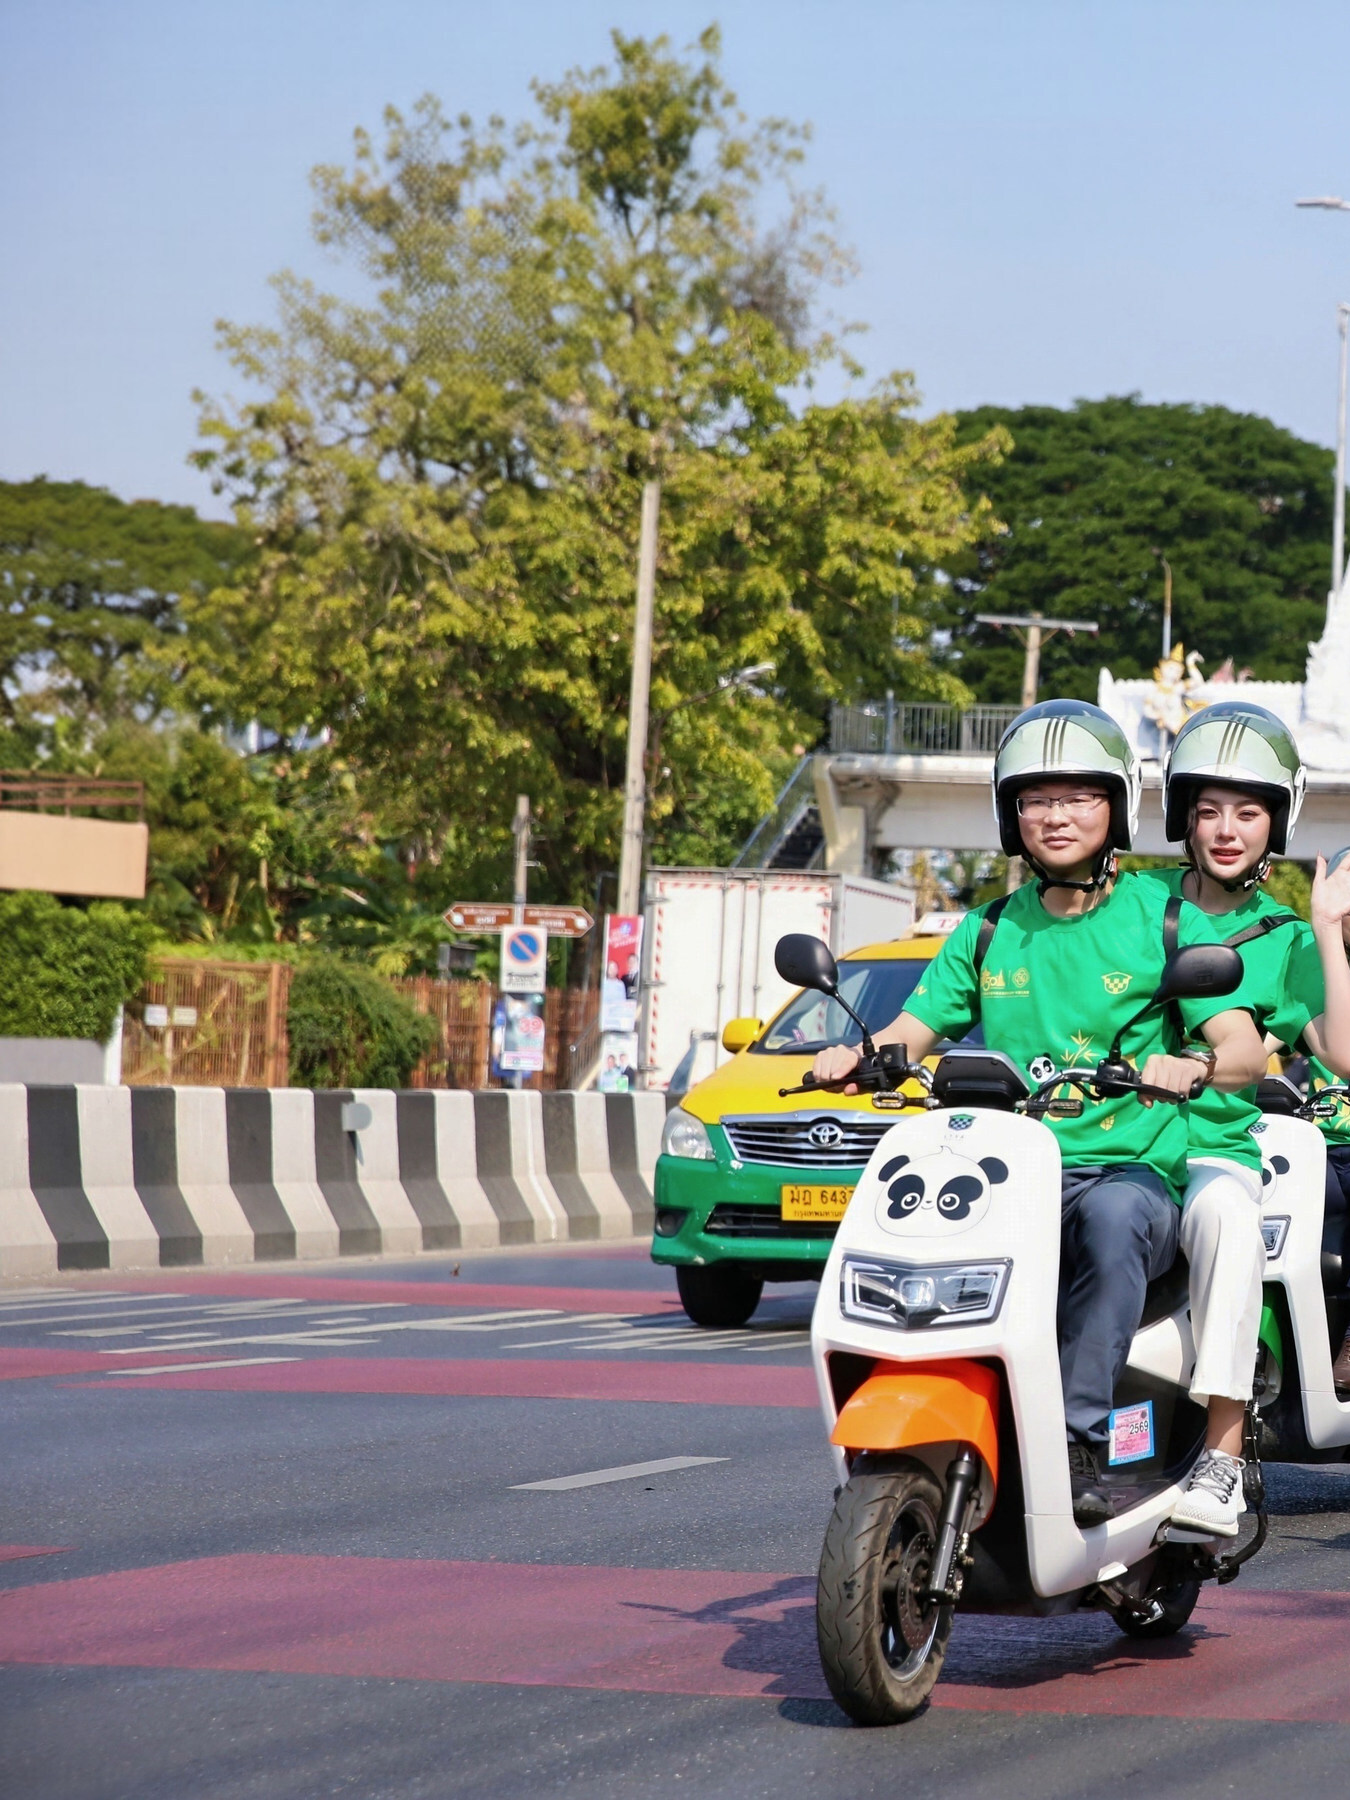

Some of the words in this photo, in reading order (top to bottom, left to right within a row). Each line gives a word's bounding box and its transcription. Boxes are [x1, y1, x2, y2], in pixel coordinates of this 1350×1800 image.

[938, 918, 960, 930] TA
[820, 1189, 855, 1205] 643
[1129, 1420, 1149, 1435] 2569
